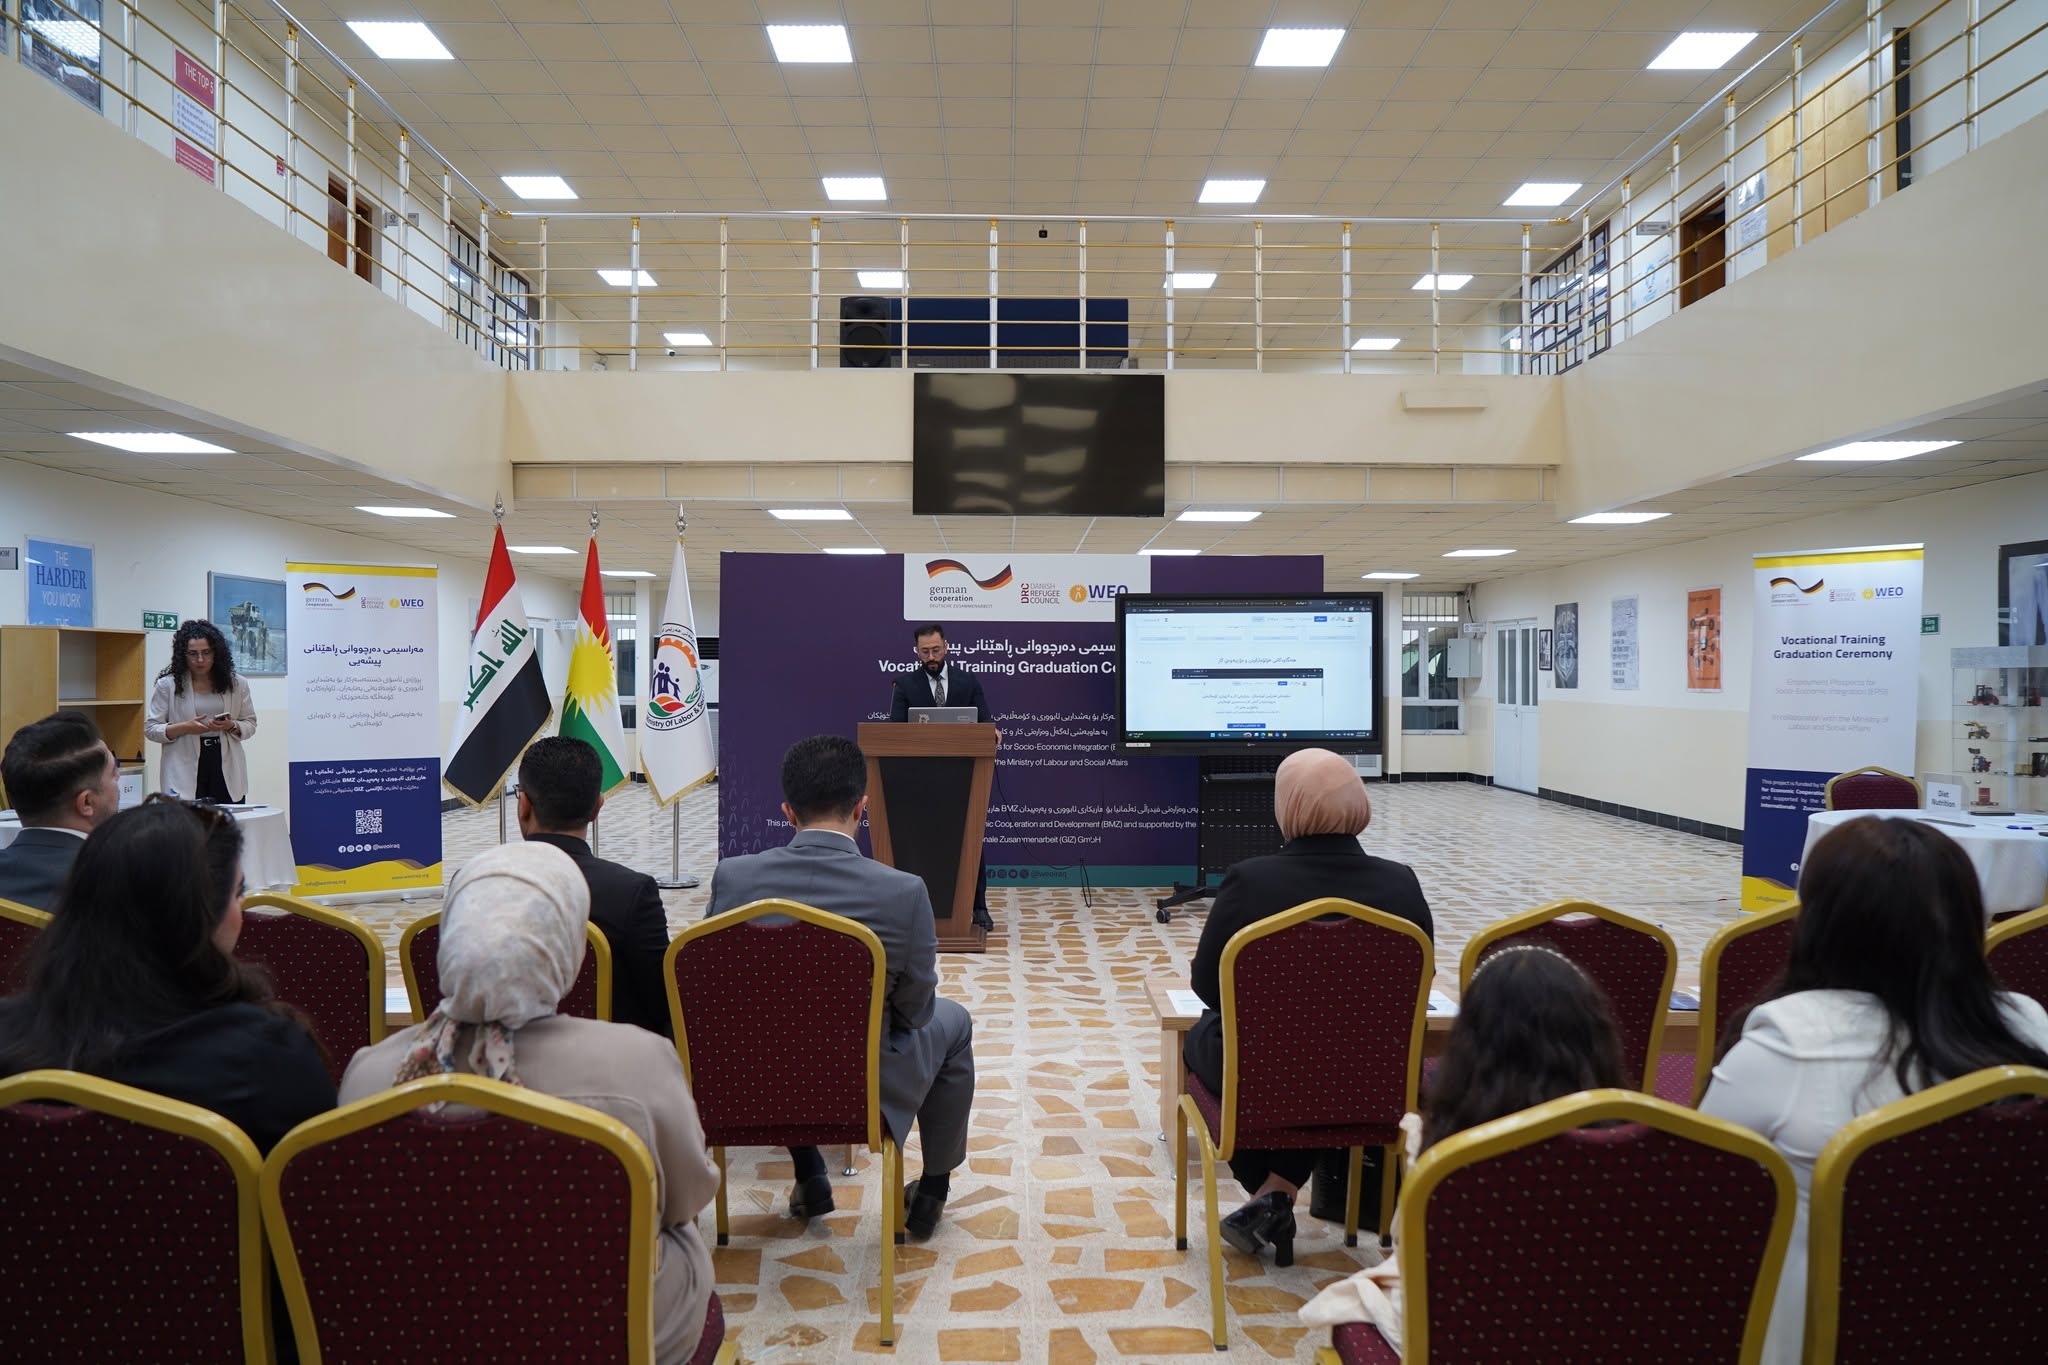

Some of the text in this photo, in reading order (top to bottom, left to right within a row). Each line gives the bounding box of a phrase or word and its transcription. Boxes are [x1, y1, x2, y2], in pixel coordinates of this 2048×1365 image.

[184, 61, 214, 95] THE TOP 5
[55, 550, 70, 567] THE
[36, 565, 87, 590] HARDER
[929, 586, 968, 596] german
[1020, 582, 1030, 604] DRC
[1875, 586, 1904, 597] WEO
[42, 591, 81, 608] YOU WORK
[400, 598, 424, 607] WEO
[929, 595, 974, 603] cooperation
[1030, 597, 1060, 605] COUNCIL
[1781, 634, 1886, 646] Vocational Training
[303, 644, 424, 657] مەراسیمی دەرچووانی ڕاهێنانی
[963, 639, 1013, 658] ڕاهێنانی
[1015, 639, 1076, 657] دەرچووانی
[1773, 649, 1893, 660] Graduation Ceremony
[348, 656, 382, 667] پیشەیی
[957, 660, 1015, 676] Training
[1018, 660, 1098, 674] Graduation
[665, 718, 674, 728] Of
[674, 712, 694, 726] Labor
[1091, 712, 1099, 721] بۆ
[1014, 727, 1024, 736] کار
[1100, 729, 1108, 737] بە
[1003, 742, 1013, 750] for
[1013, 742, 1072, 751] Socio-Economic
[1073, 743, 1110, 752] Integration
[1006, 758, 1034, 768] Ministry
[1034, 758, 1043, 766] of
[1043, 758, 1069, 767] Labour
[1069, 759, 1083, 767] and
[1083, 758, 1106, 767] Social
[1106, 758, 1129, 767] Affairs
[766, 819, 781, 827] This
[1039, 820, 1054, 828] and
[1053, 820, 1100, 830] Development
[1100, 820, 1123, 830] (BMZ)
[1123, 820, 1138, 828] and
[1138, 820, 1175, 830] supported
[1175, 820, 1185, 829] by
[1185, 820, 1197, 828] the
[1059, 836, 1077, 845] (GIZ)
[1031, 870, 1067, 880] @weoiraq
